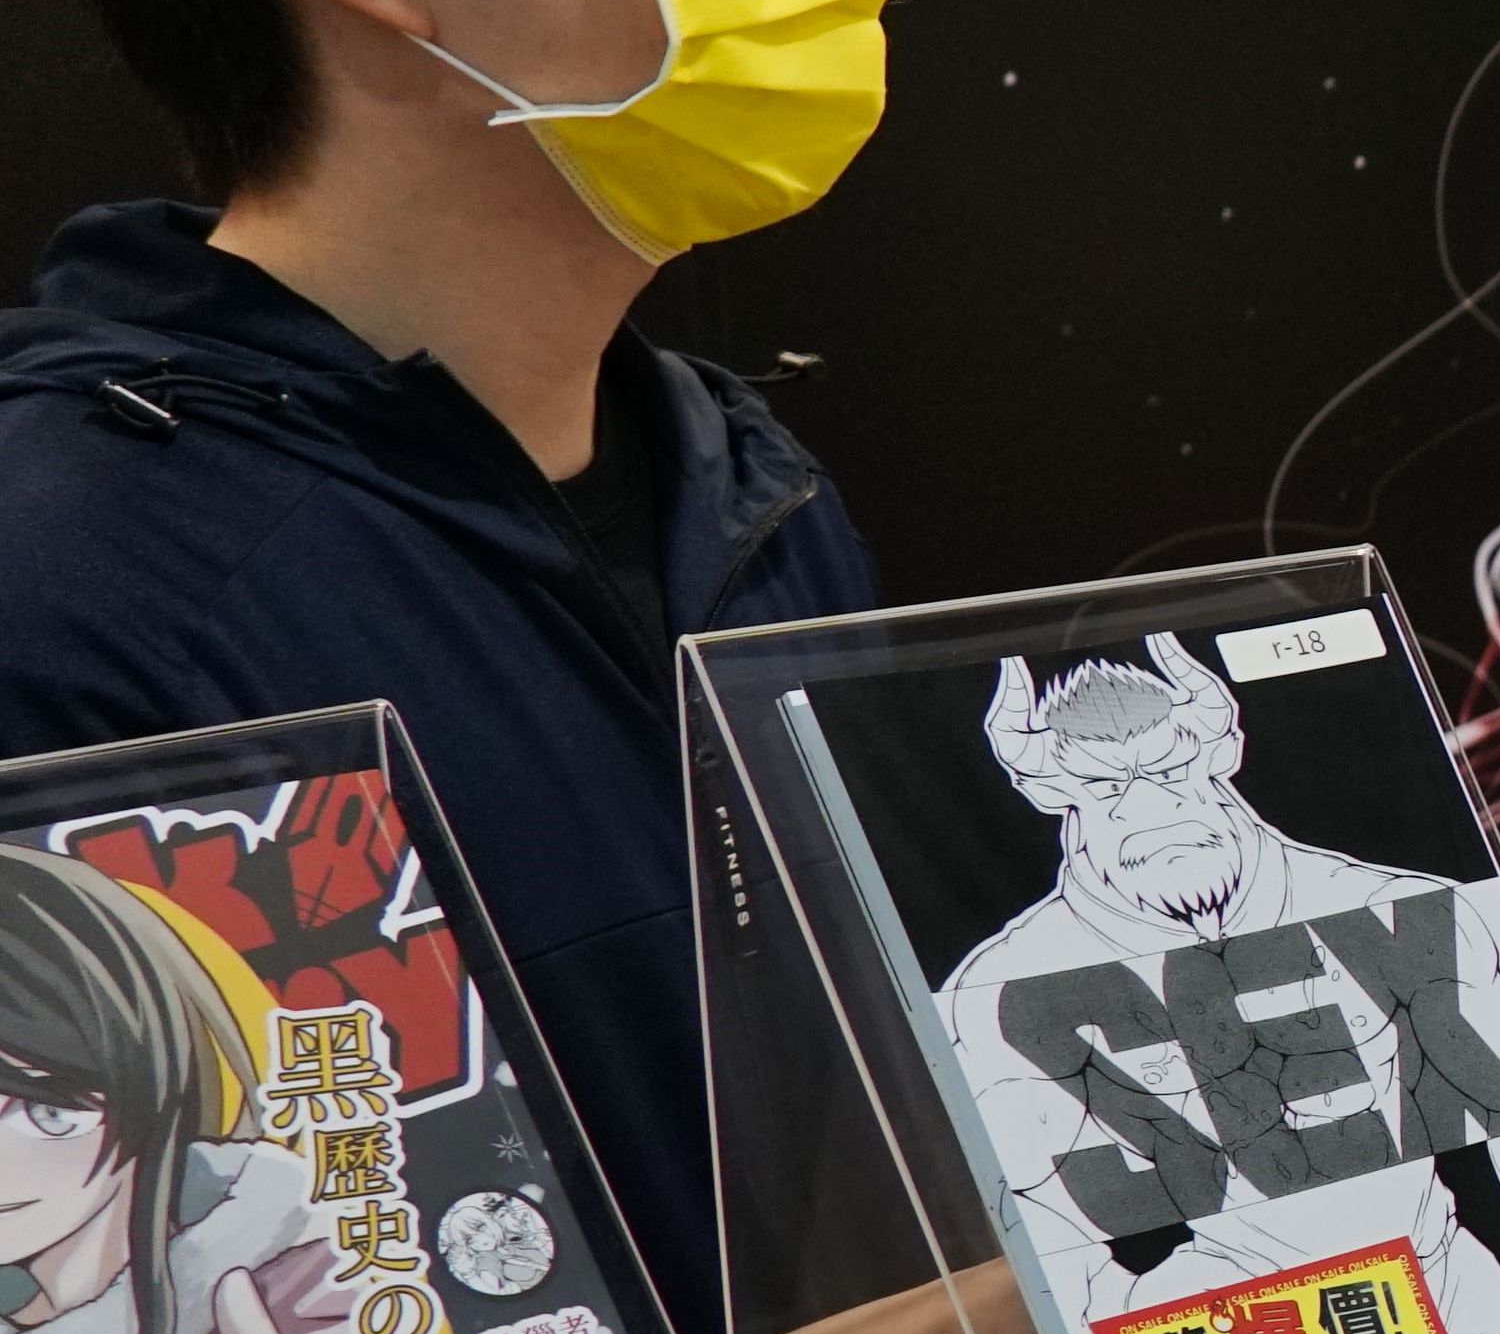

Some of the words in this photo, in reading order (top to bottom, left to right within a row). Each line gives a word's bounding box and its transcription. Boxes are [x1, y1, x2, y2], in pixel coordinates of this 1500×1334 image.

[1271, 629, 1326, 659] r-18
[715, 806, 752, 927] FITNESS
[1396, 1253, 1413, 1274] ON
[1138, 1317, 1163, 1331] SALE
[1167, 1311, 1184, 1324] ON
[1185, 1303, 1210, 1318] SALE
[1258, 1285, 1276, 1298] ON
[1276, 1279, 1301, 1293] SALE
[1303, 1274, 1320, 1286] ON
[1320, 1266, 1345, 1281] SALE
[1348, 1261, 1364, 1273] ON
[1365, 1253, 1389, 1268] SALE
[1404, 1272, 1422, 1300] SALE
[1417, 1301, 1432, 1322] ON
